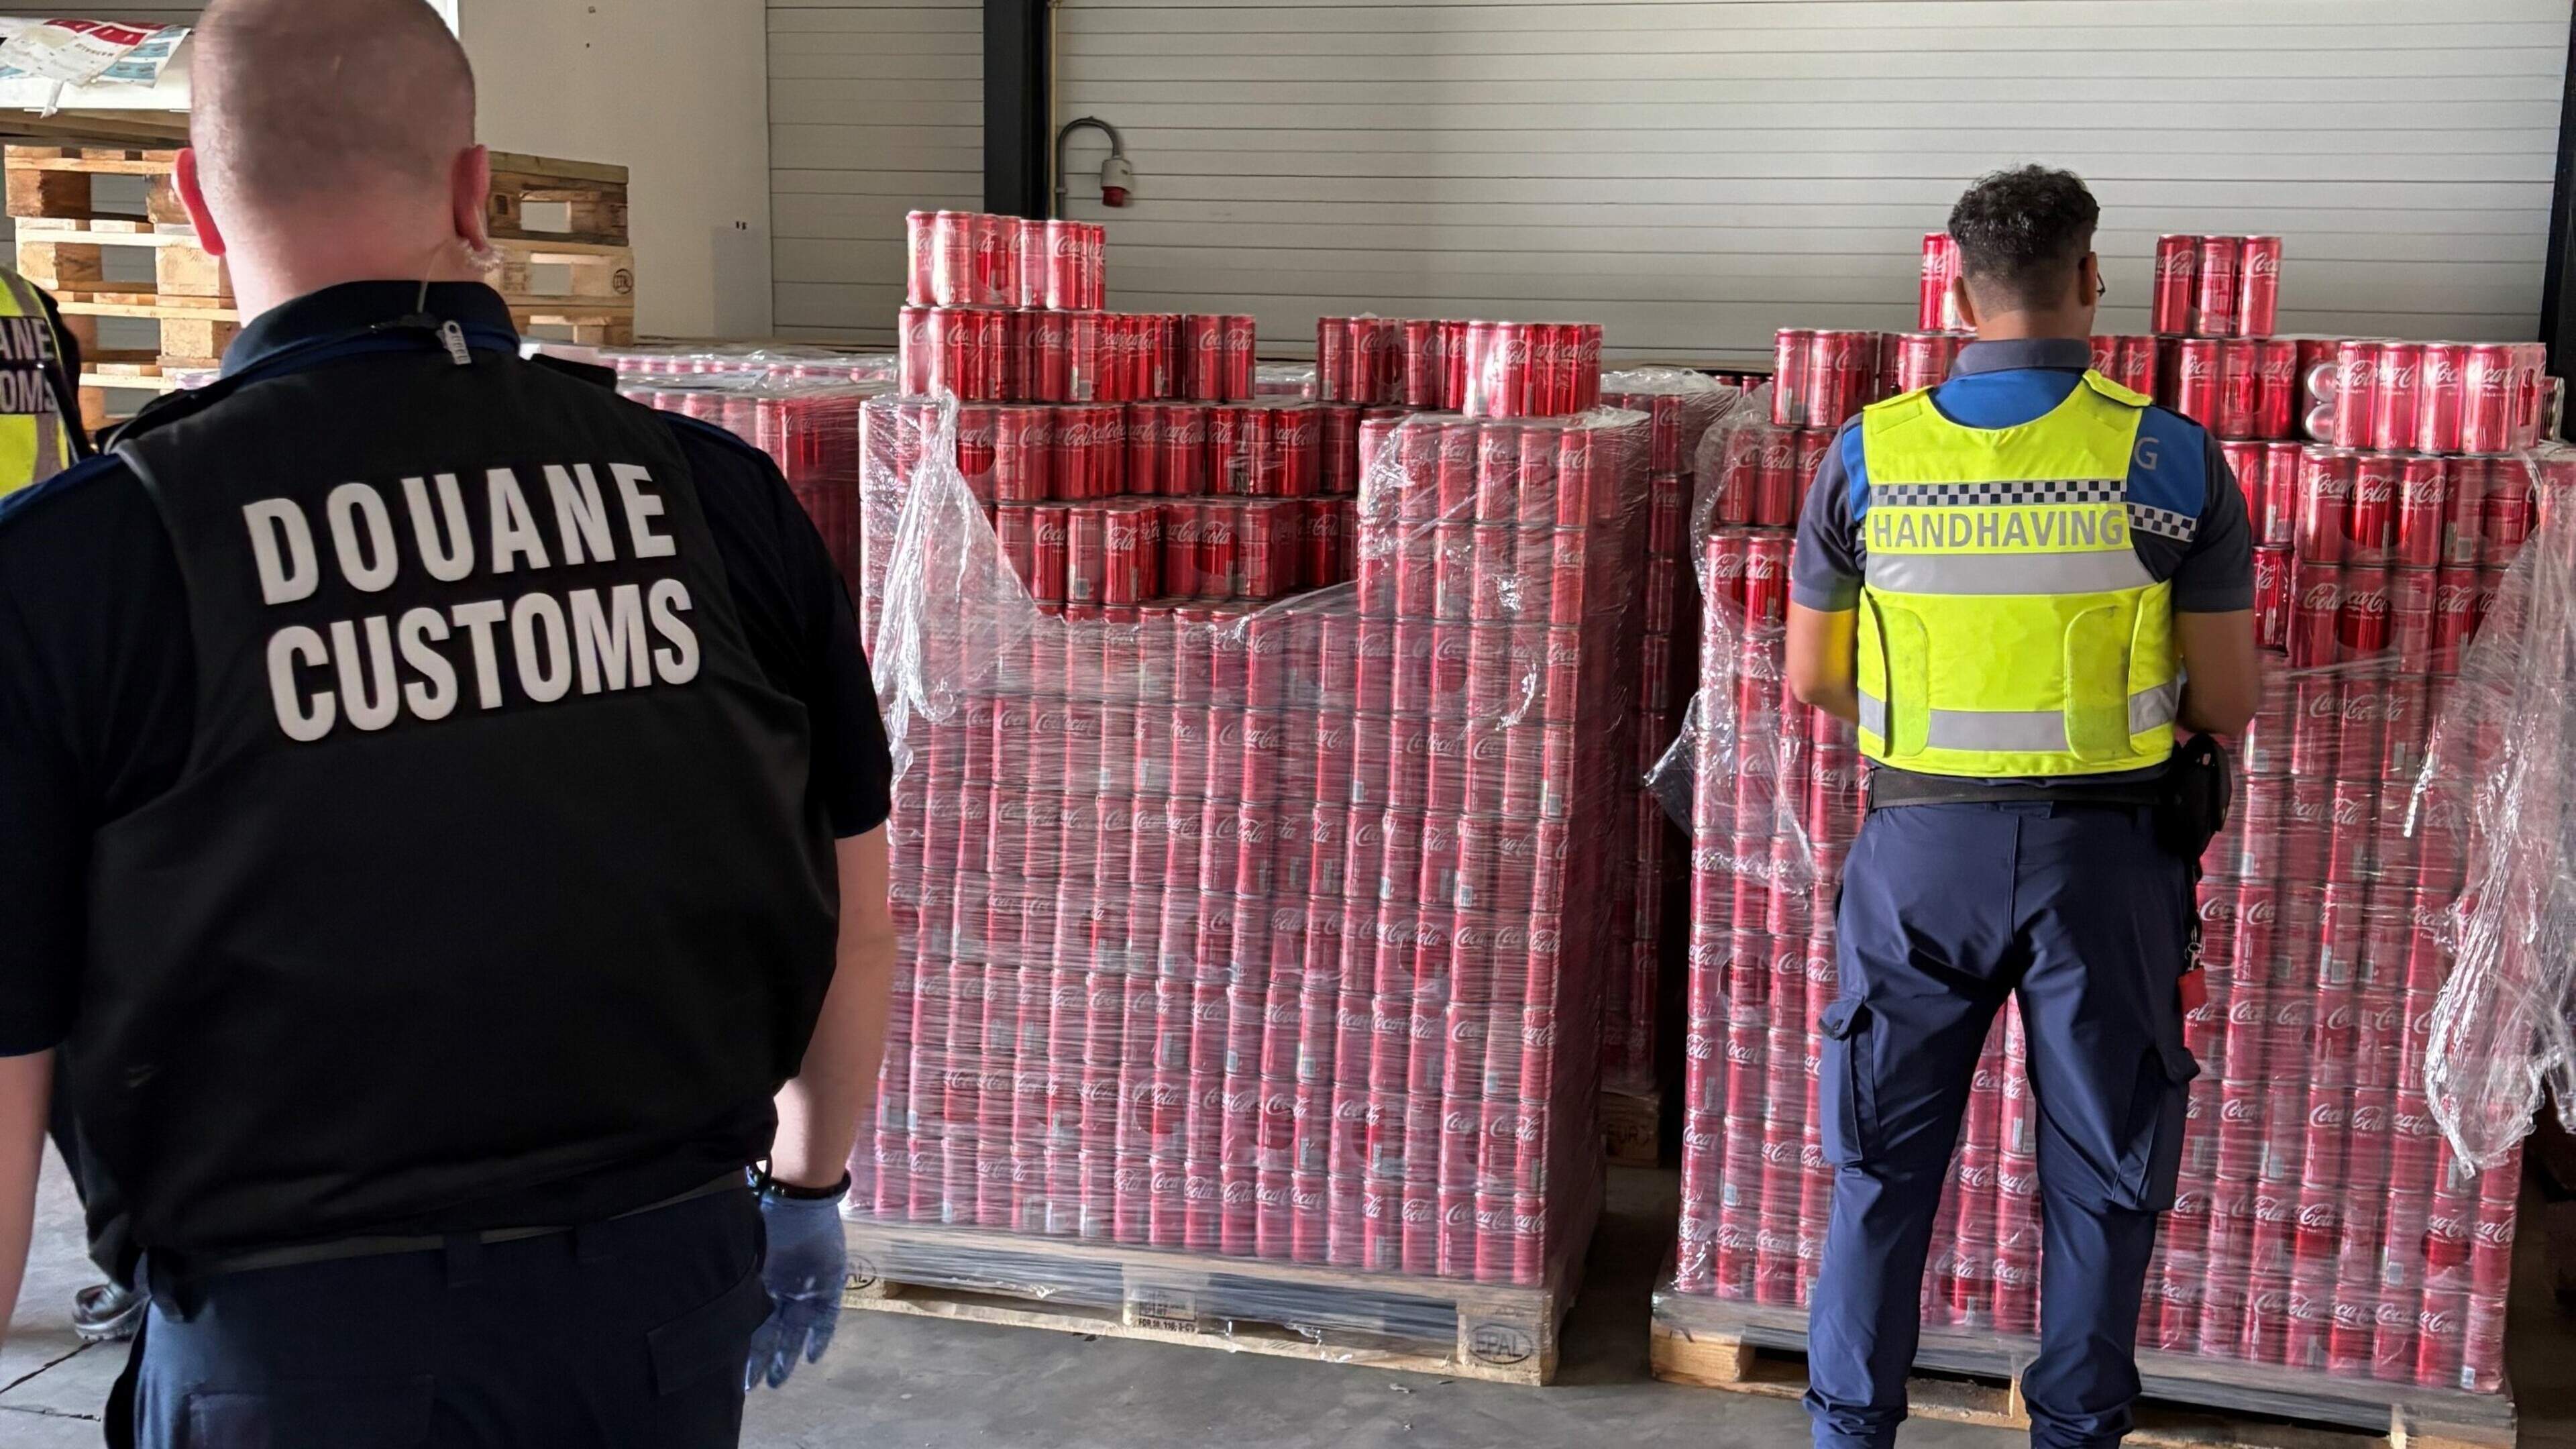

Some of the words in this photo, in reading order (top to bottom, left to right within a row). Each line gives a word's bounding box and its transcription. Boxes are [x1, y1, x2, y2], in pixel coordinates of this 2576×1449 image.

[242, 463, 676, 605] DOUANE
[1874, 511, 2123, 548] HANDHAVING
[268, 578, 700, 742] CUSTOMS
[2186, 1002, 2212, 1022] ola
[2221, 1099, 2257, 1122] Coca
[1151, 1172, 1181, 1193] Coca
